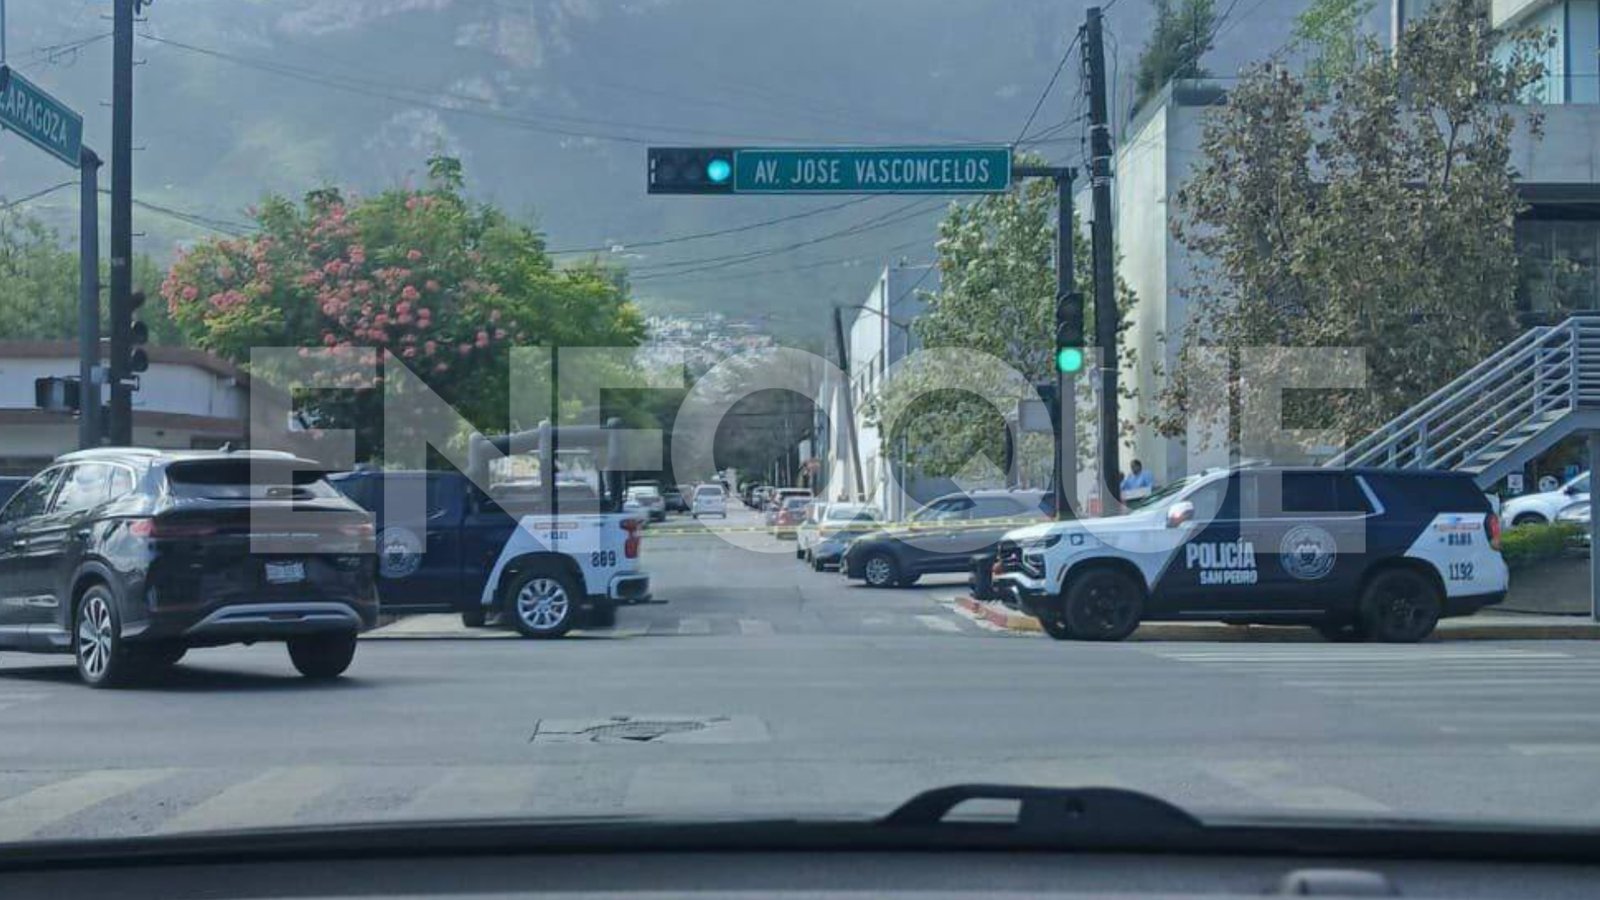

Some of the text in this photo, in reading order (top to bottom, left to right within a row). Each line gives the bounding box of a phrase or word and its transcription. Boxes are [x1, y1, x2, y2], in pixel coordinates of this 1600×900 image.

[754, 159, 990, 184] AV. JOSE VASCONCELOS
[1185, 537, 1257, 569] POLICÍA
[1200, 569, 1258, 585] SAN PEDRO
[1448, 561, 1475, 581] 1192
